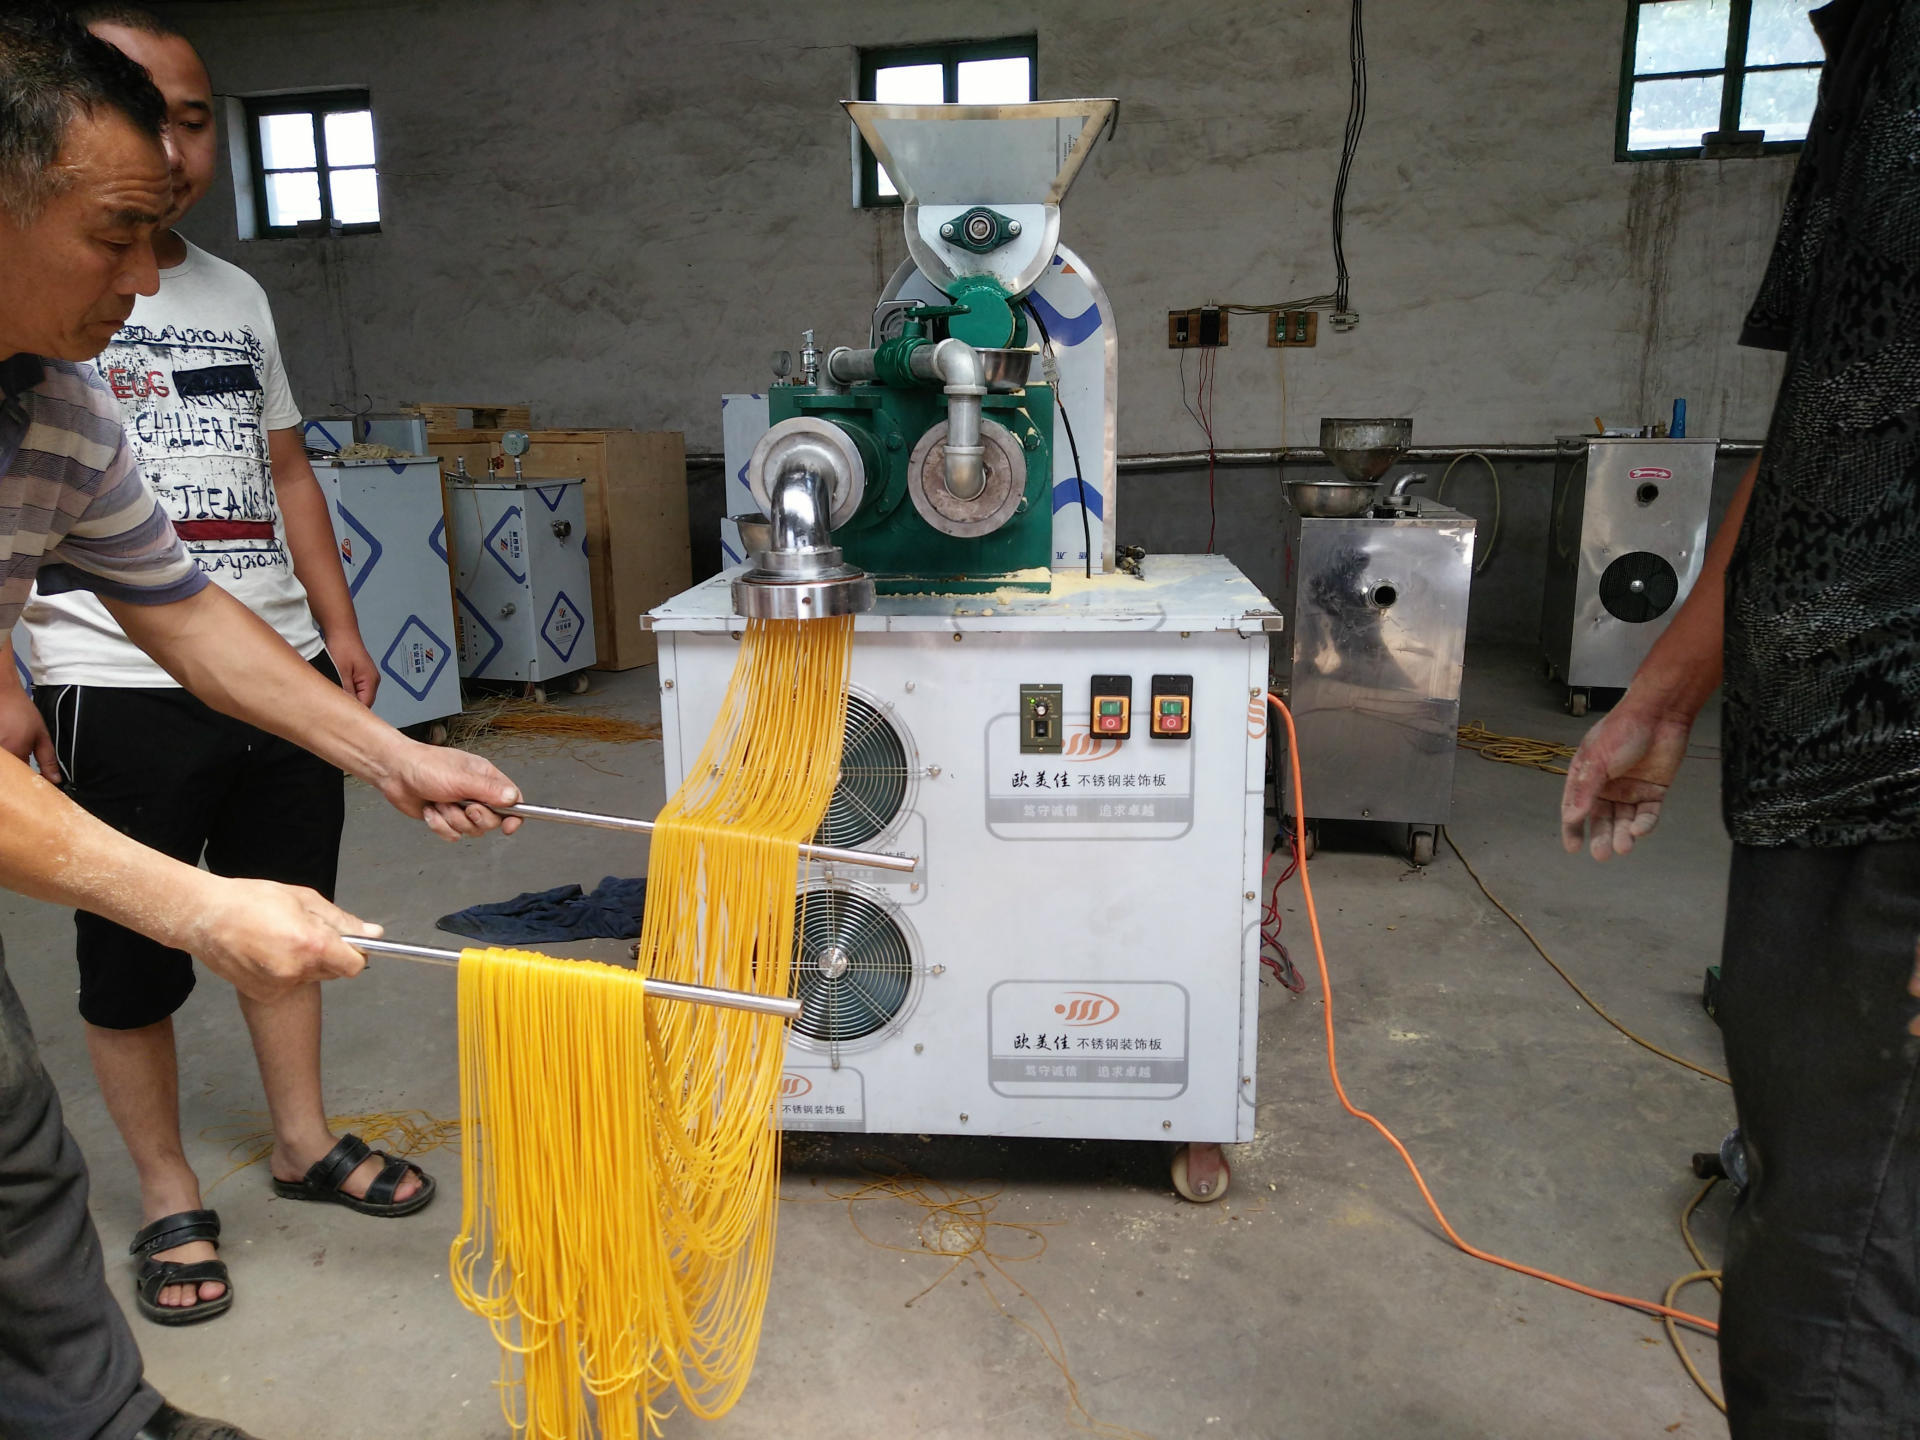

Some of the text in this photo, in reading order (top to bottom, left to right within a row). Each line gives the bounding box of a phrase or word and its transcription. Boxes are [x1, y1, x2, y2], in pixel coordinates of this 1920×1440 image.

[1011, 769, 1167, 789] 欧美佳 不锈钢装饰板
[1099, 804, 1155, 817] 追求卓越
[1013, 1032, 1162, 1051] 欧美佳 不锈钢装饰板
